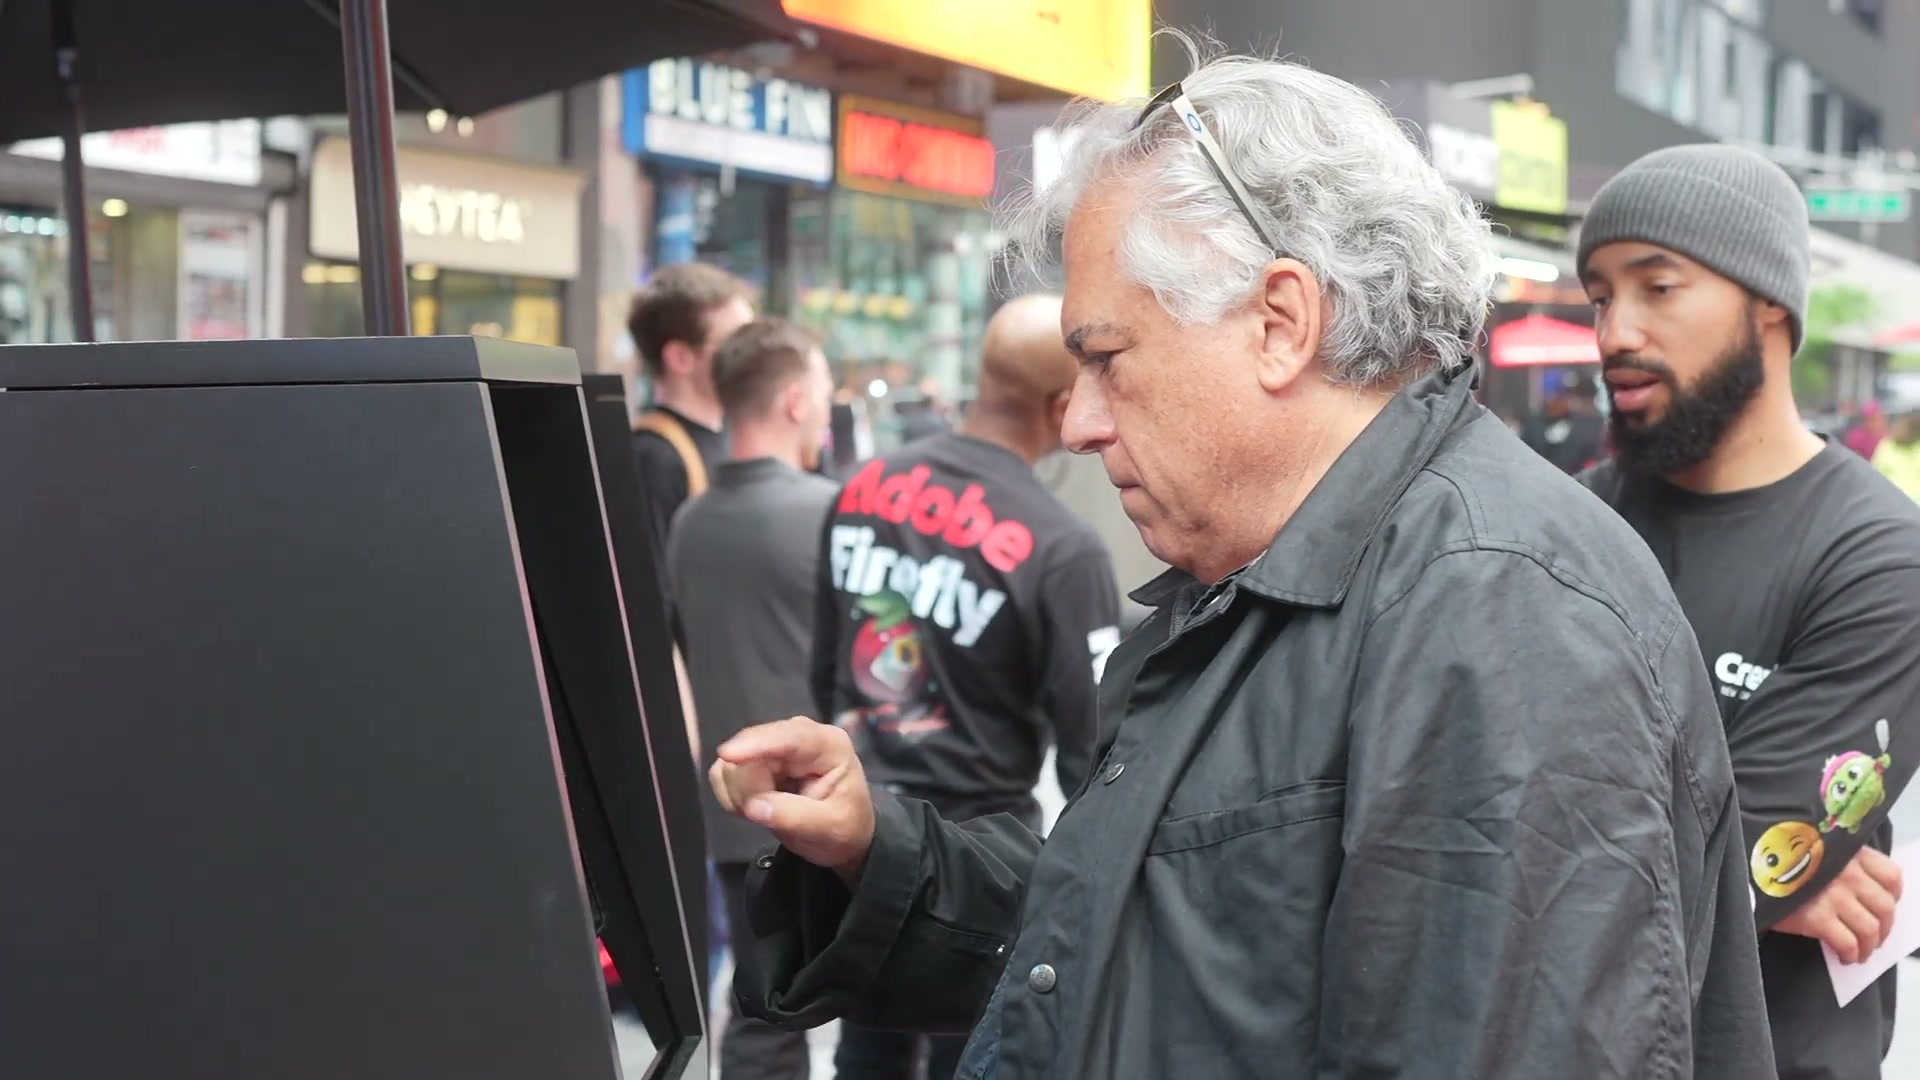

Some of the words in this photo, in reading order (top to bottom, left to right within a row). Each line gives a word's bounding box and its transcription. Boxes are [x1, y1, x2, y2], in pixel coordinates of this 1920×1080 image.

[648, 57, 756, 129] BLUE
[765, 77, 832, 143] FIN
[838, 460, 1034, 573] Adobe
[830, 524, 1007, 648] Firefly
[1714, 651, 1779, 692] Cre
